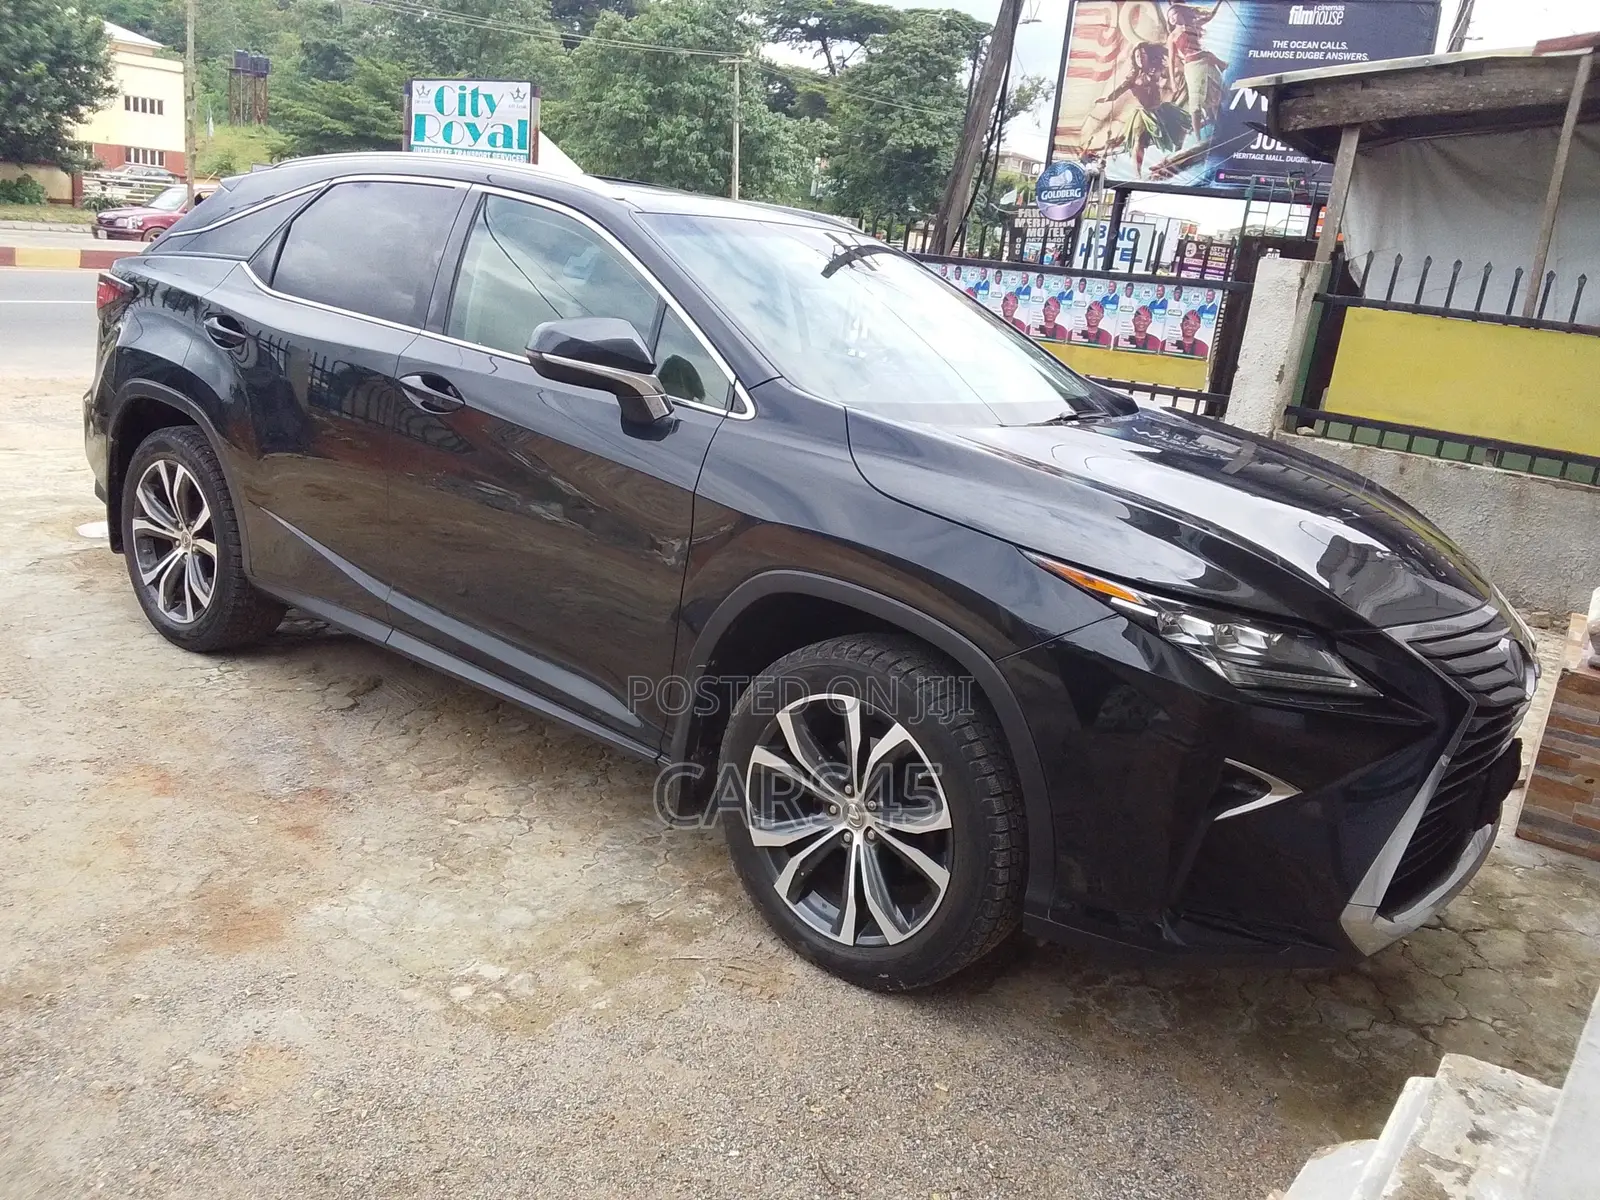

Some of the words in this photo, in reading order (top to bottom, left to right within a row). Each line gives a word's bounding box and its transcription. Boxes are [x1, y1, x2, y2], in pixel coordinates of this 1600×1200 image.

[1288, 5, 1344, 26] filmhouse
[1272, 40, 1289, 49] THE
[1290, 41, 1319, 49] OCEAN
[1320, 41, 1349, 50] CALLS.
[1248, 50, 1295, 59] FILMHOUSE
[1296, 51, 1325, 60] DUGBE
[1326, 52, 1370, 61] ANSWERS.
[434, 85, 504, 119] City
[413, 114, 528, 150] Royal
[1250, 132, 1294, 152] JUL
[1233, 152, 1264, 161] HERITAGE
[1041, 188, 1081, 201] GOLDBERG
